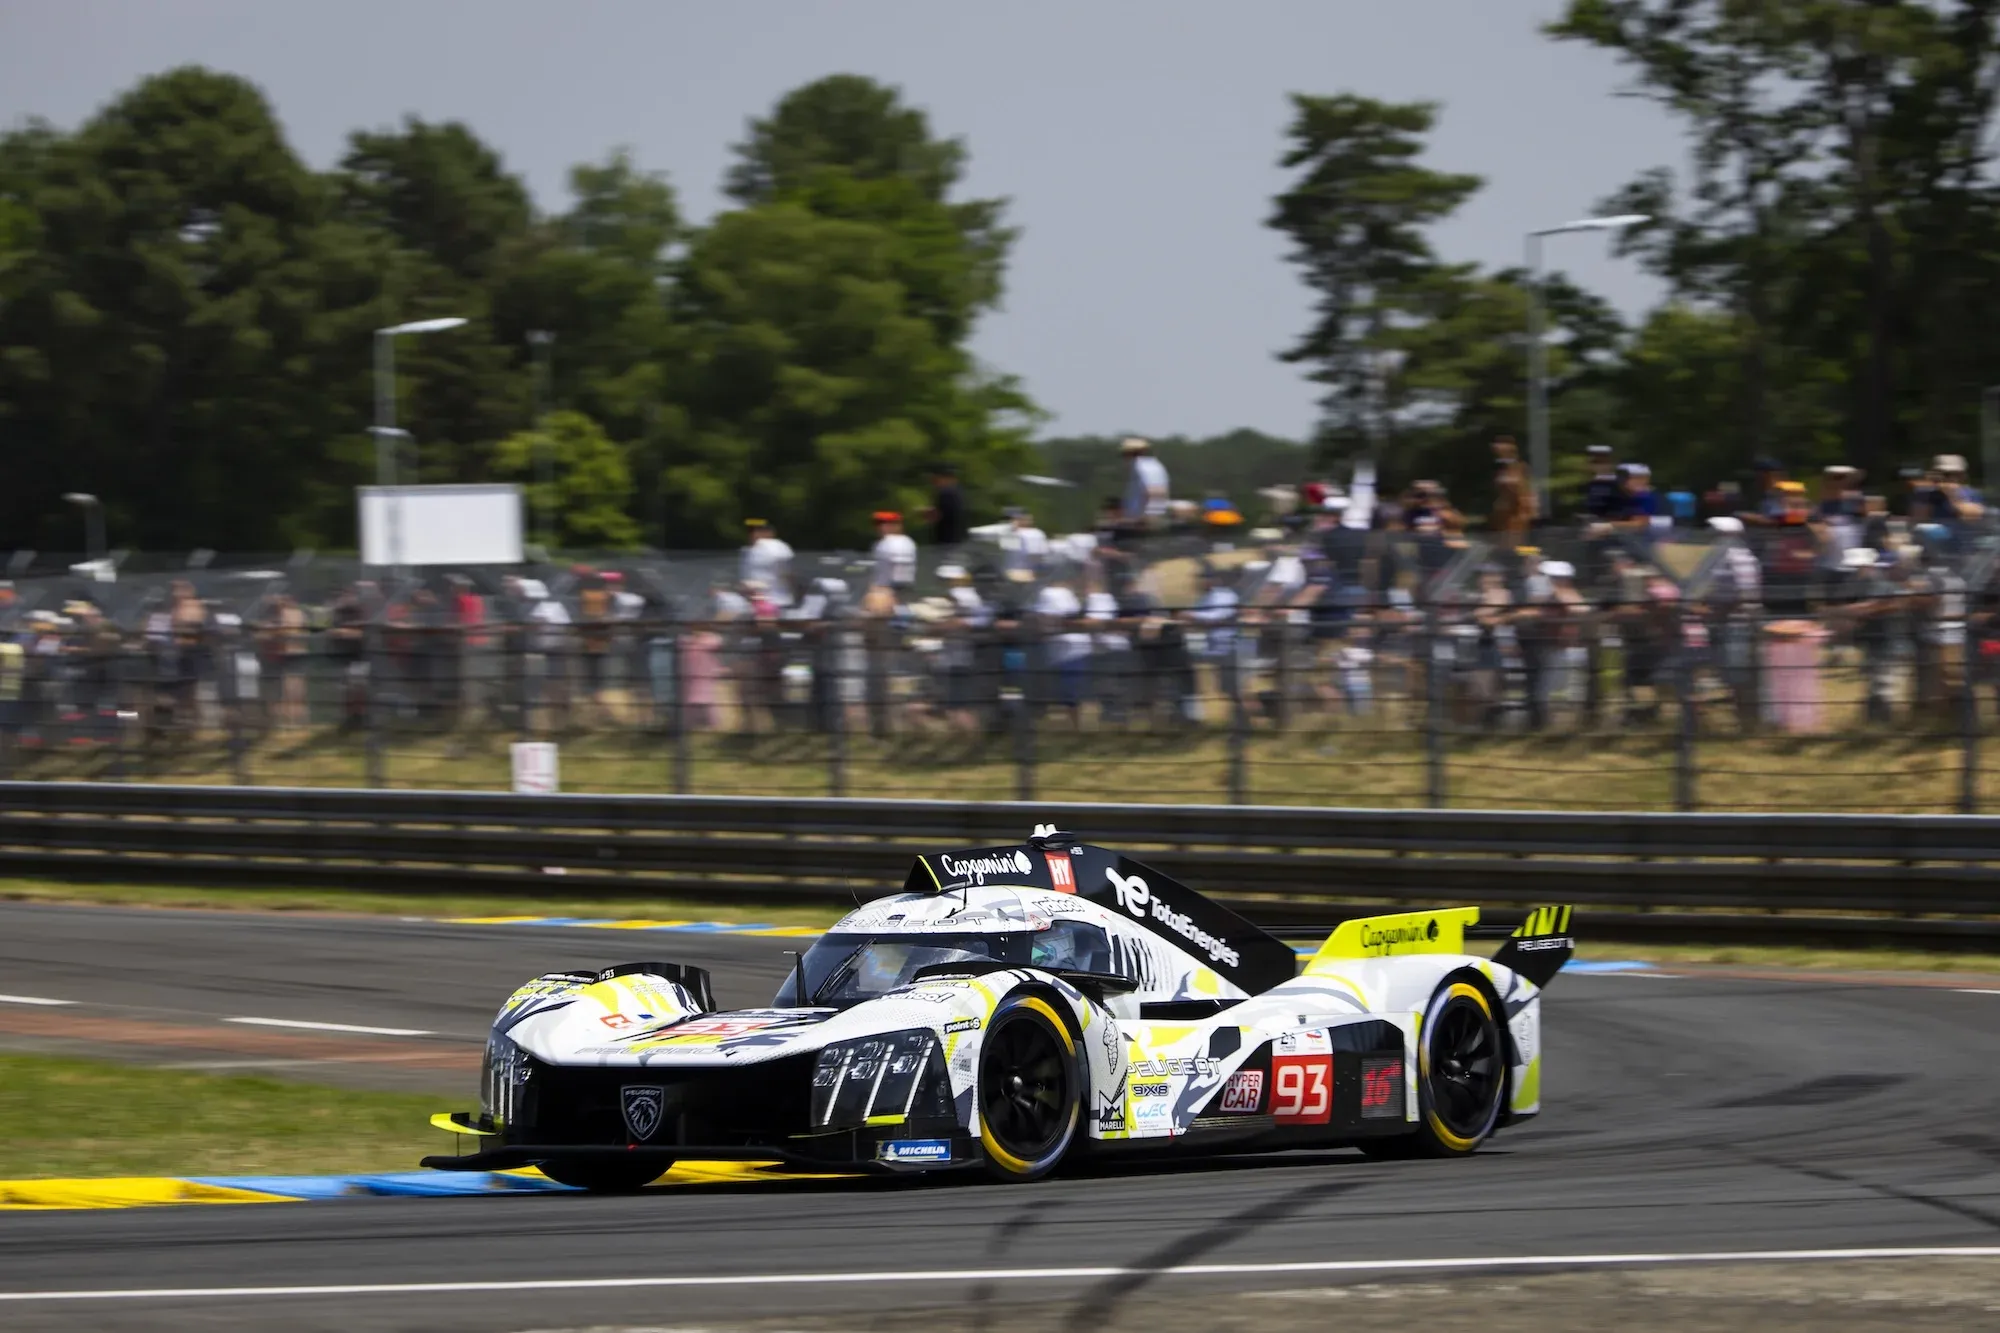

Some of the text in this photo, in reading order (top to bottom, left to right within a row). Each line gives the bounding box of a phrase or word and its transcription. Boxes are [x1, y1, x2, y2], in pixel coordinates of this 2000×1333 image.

[941, 852, 1018, 885] Capgemini
[1048, 859, 1071, 885] HY
[1032, 896, 1085, 917] yahoo!
[1148, 895, 1241, 968] TotalEnergies
[1360, 920, 1426, 956] Capgemini
[674, 1023, 750, 1035] 93
[1127, 1056, 1221, 1078] PEUGEOT
[1131, 1082, 1171, 1098] 9X8
[1227, 1074, 1261, 1088] HYPER
[1273, 1064, 1329, 1116] 93
[1223, 1088, 1259, 1110] CAR
[1136, 1103, 1167, 1118] WEC
[1099, 1121, 1125, 1131] MARELLI
[898, 1145, 946, 1156] MICHELIN
